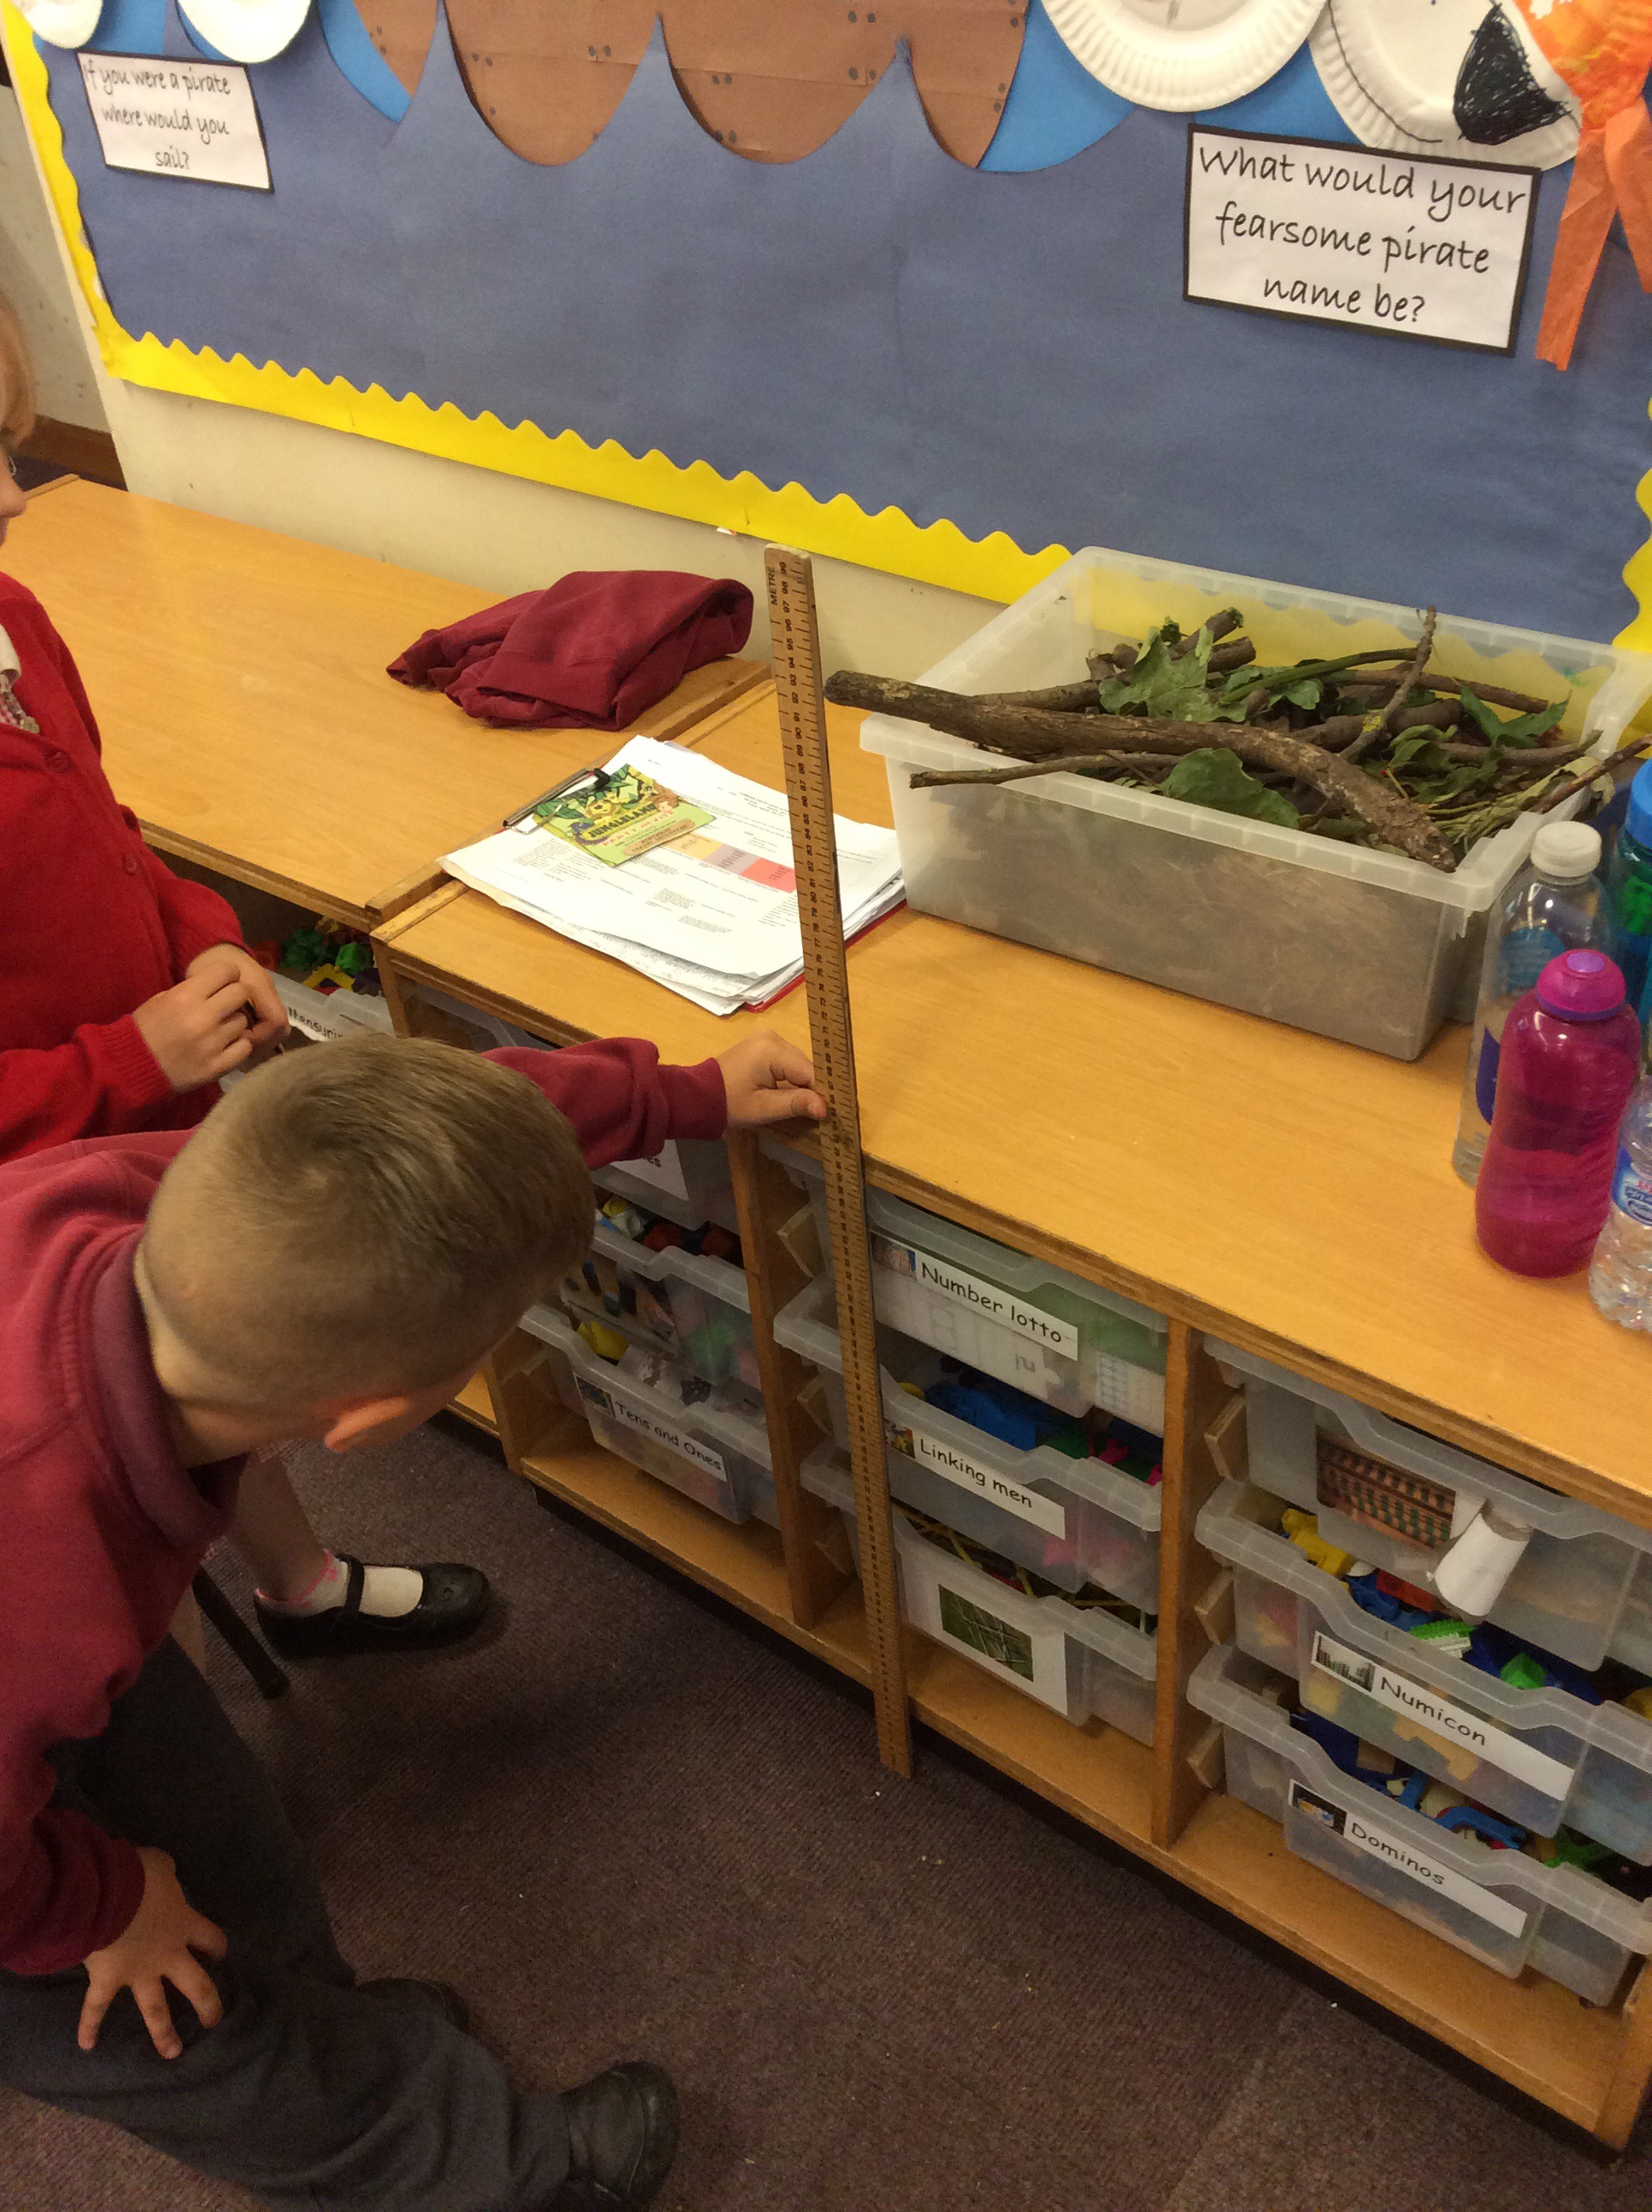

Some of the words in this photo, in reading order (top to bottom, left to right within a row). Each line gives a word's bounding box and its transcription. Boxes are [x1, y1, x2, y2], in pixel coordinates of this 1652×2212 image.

[101, 68, 130, 96] you
[133, 72, 166, 89] were
[170, 73, 179, 89] a
[182, 67, 230, 101] pirate
[102, 104, 143, 126] where
[145, 108, 193, 131] would
[196, 118, 230, 145] you
[155, 145, 189, 170] sail?
[1199, 146, 1295, 183] What
[1306, 163, 1416, 199] would
[1427, 178, 1527, 223] your
[1215, 200, 1372, 256] fearsome
[1381, 225, 1491, 273] pirate
[1263, 277, 1361, 314] name
[1374, 282, 1426, 323] be?
[779, 562, 787, 574] 99
[768, 566, 778, 606] METRE
[781, 581, 788, 594] 98
[782, 601, 790, 614] 97
[785, 620, 792, 632] 96
[787, 637, 794, 650] 95
[788, 657, 795, 668] 94
[789, 674, 797, 686] 93
[792, 692, 799, 704] 92
[794, 712, 800, 722] 91
[795, 728, 802, 739] 90
[796, 745, 804, 757] 89
[798, 763, 806, 775] 88
[921, 1261, 1003, 1313] Number
[1010, 1305, 1062, 1343] lotto
[614, 1400, 650, 1430] Tens
[654, 1426, 679, 1447] and
[683, 1441, 722, 1471] Ones
[920, 1438, 986, 1487] Linking
[992, 1479, 1032, 1509] men
[1380, 1676, 1486, 1746] Numicon
[1350, 1822, 1446, 1885] Dominos
